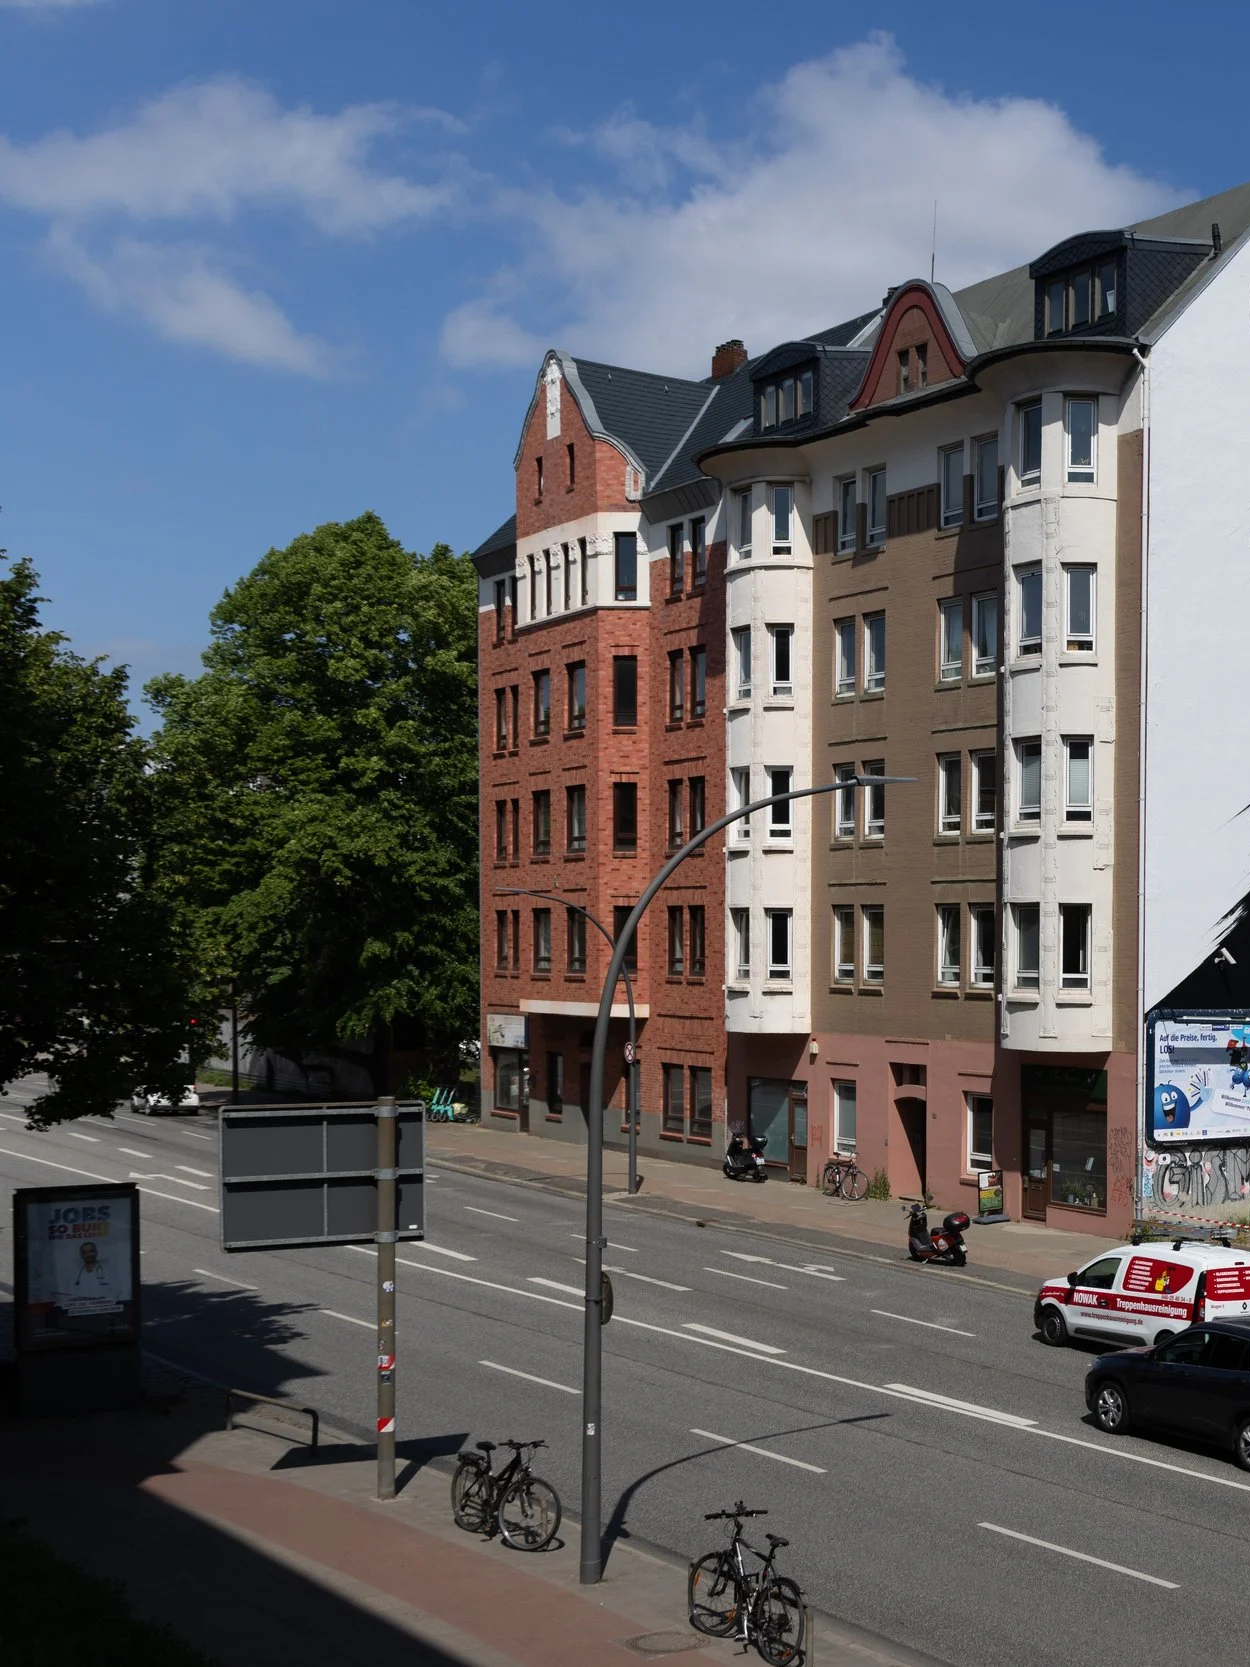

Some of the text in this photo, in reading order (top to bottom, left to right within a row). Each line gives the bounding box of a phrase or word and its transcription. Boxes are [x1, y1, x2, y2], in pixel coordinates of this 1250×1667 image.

[1160, 1034, 1169, 1042] Auf
[1180, 1034, 1199, 1042] Preise,
[1159, 1045, 1175, 1054] LOS!
[48, 1205, 111, 1224] JOBS
[48, 1224, 68, 1235] SO
[1073, 1292, 1098, 1306] NOWAK
[1116, 1298, 1188, 1318] Treppenhausreinigung
[1080, 1311, 1144, 1325] www.treppenhausreinigung.de
